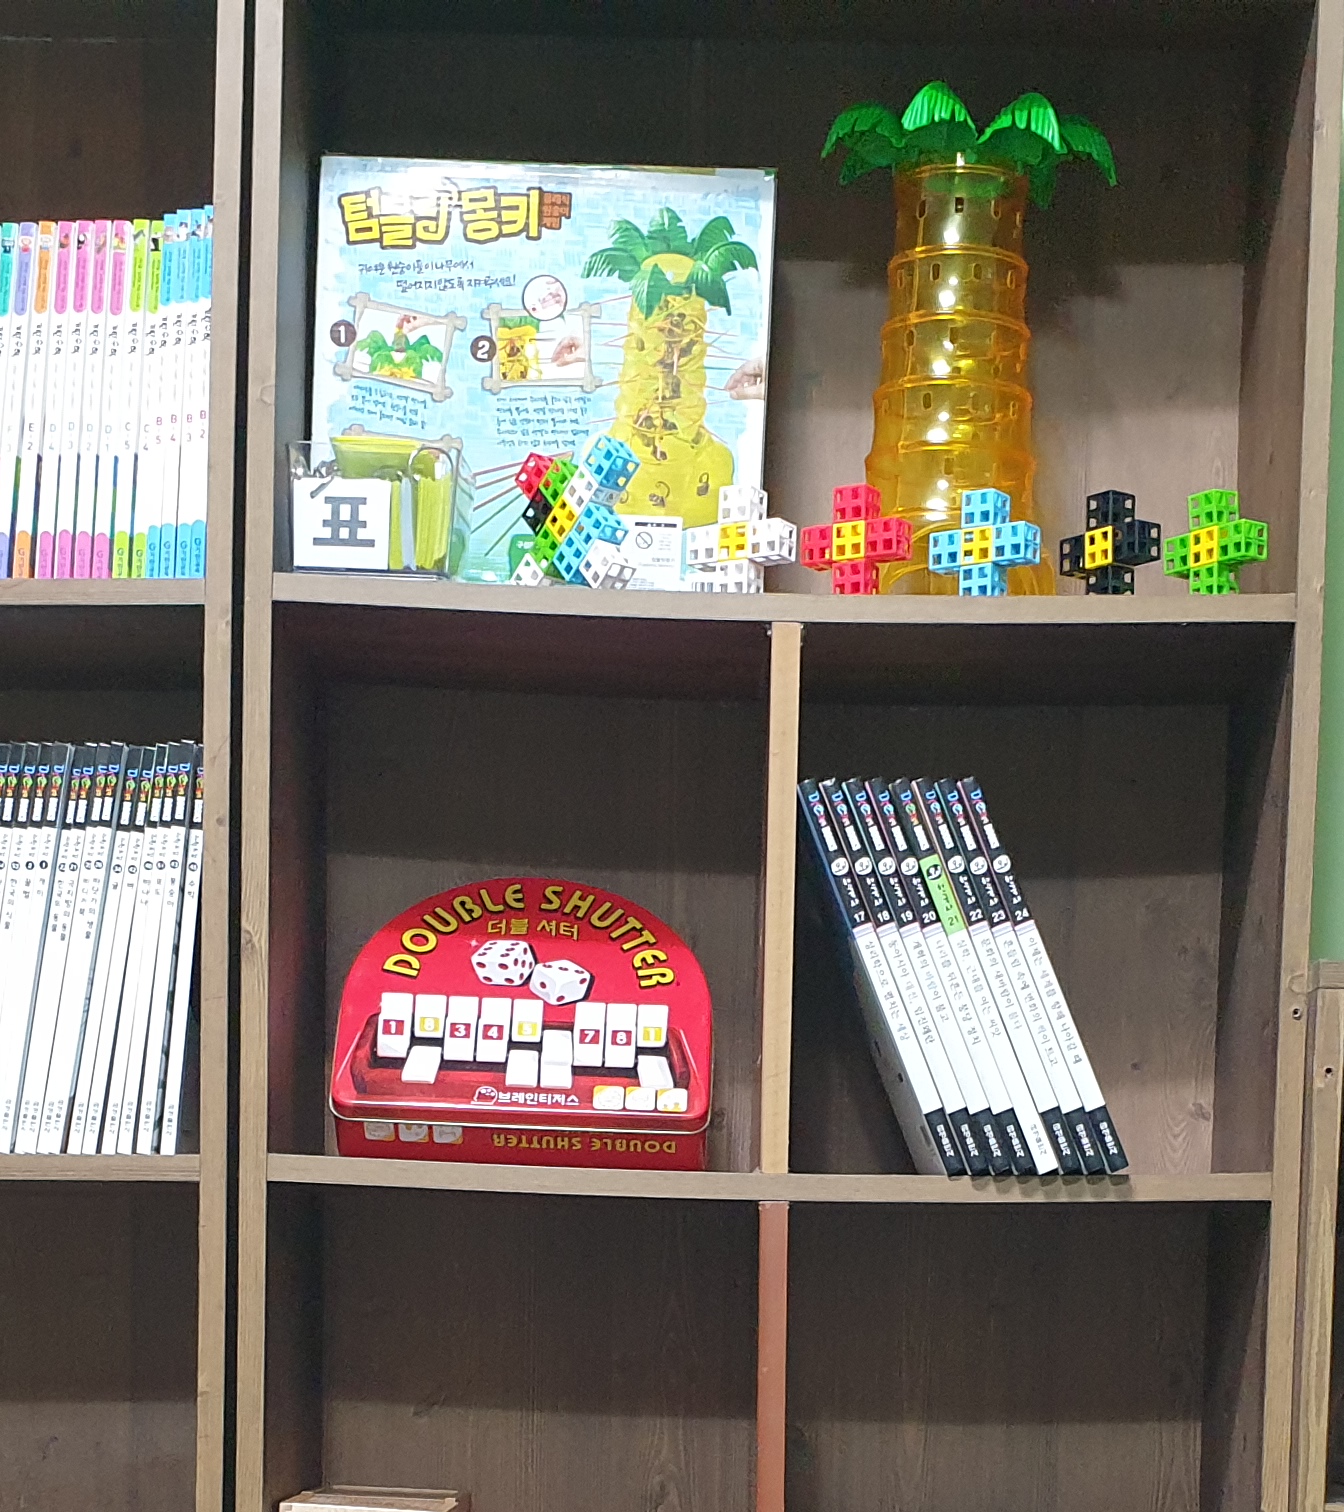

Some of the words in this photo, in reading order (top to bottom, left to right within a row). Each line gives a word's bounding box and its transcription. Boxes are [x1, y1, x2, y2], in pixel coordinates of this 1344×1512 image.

[456, 185, 544, 243] 몽키
[337, 325, 347, 344] 1
[476, 340, 490, 360] 2
[312, 496, 377, 548] 표
[853, 911, 867, 922] 17
[876, 910, 890, 922] 18
[899, 910, 913, 922] 19
[922, 910, 936, 923] 20
[947, 916, 959, 927] 21
[969, 908, 983, 921] 22
[991, 910, 1005, 922] 23
[1014, 908, 1028, 920] 24
[382, 884, 526, 980] DOUBLE
[540, 884, 677, 990] SHUTTER
[486, 918, 530, 936] 더블
[536, 919, 581, 941] 셔터
[387, 1020, 398, 1034] 1
[455, 1024, 468, 1039] 3
[487, 1025, 500, 1040] 4
[584, 1030, 596, 1045] 7
[616, 1031, 628, 1045] 8
[498, 1091, 580, 1106] 브레인티저스
[492, 1132, 582, 1151] SHUTTER
[591, 1138, 677, 1155] DOUBLE
